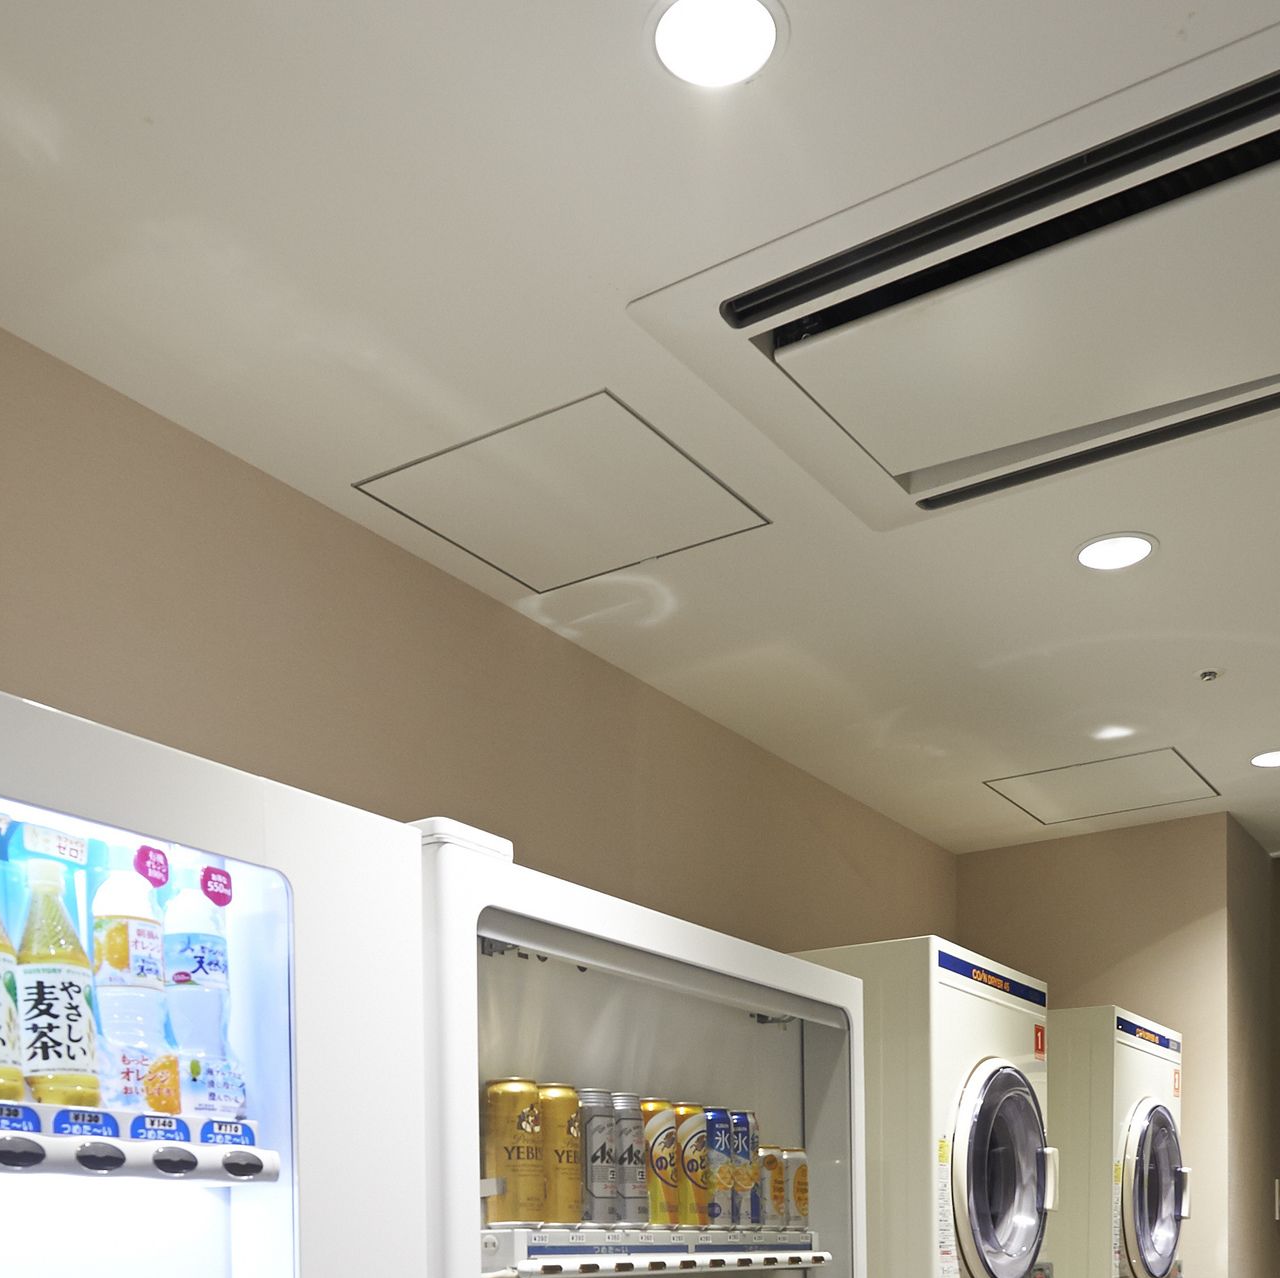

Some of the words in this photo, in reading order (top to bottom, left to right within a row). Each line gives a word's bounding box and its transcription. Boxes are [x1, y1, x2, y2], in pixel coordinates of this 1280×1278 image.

[24, 980, 63, 1061] 麦茶
[60, 981, 87, 1061] やさしい
[1036, 1031, 1043, 1050] 1
[121, 1054, 149, 1067] もっと
[121, 1067, 170, 1083] オレンジ
[149, 1118, 173, 1128] ¥140
[218, 1124, 239, 1133] ¥110
